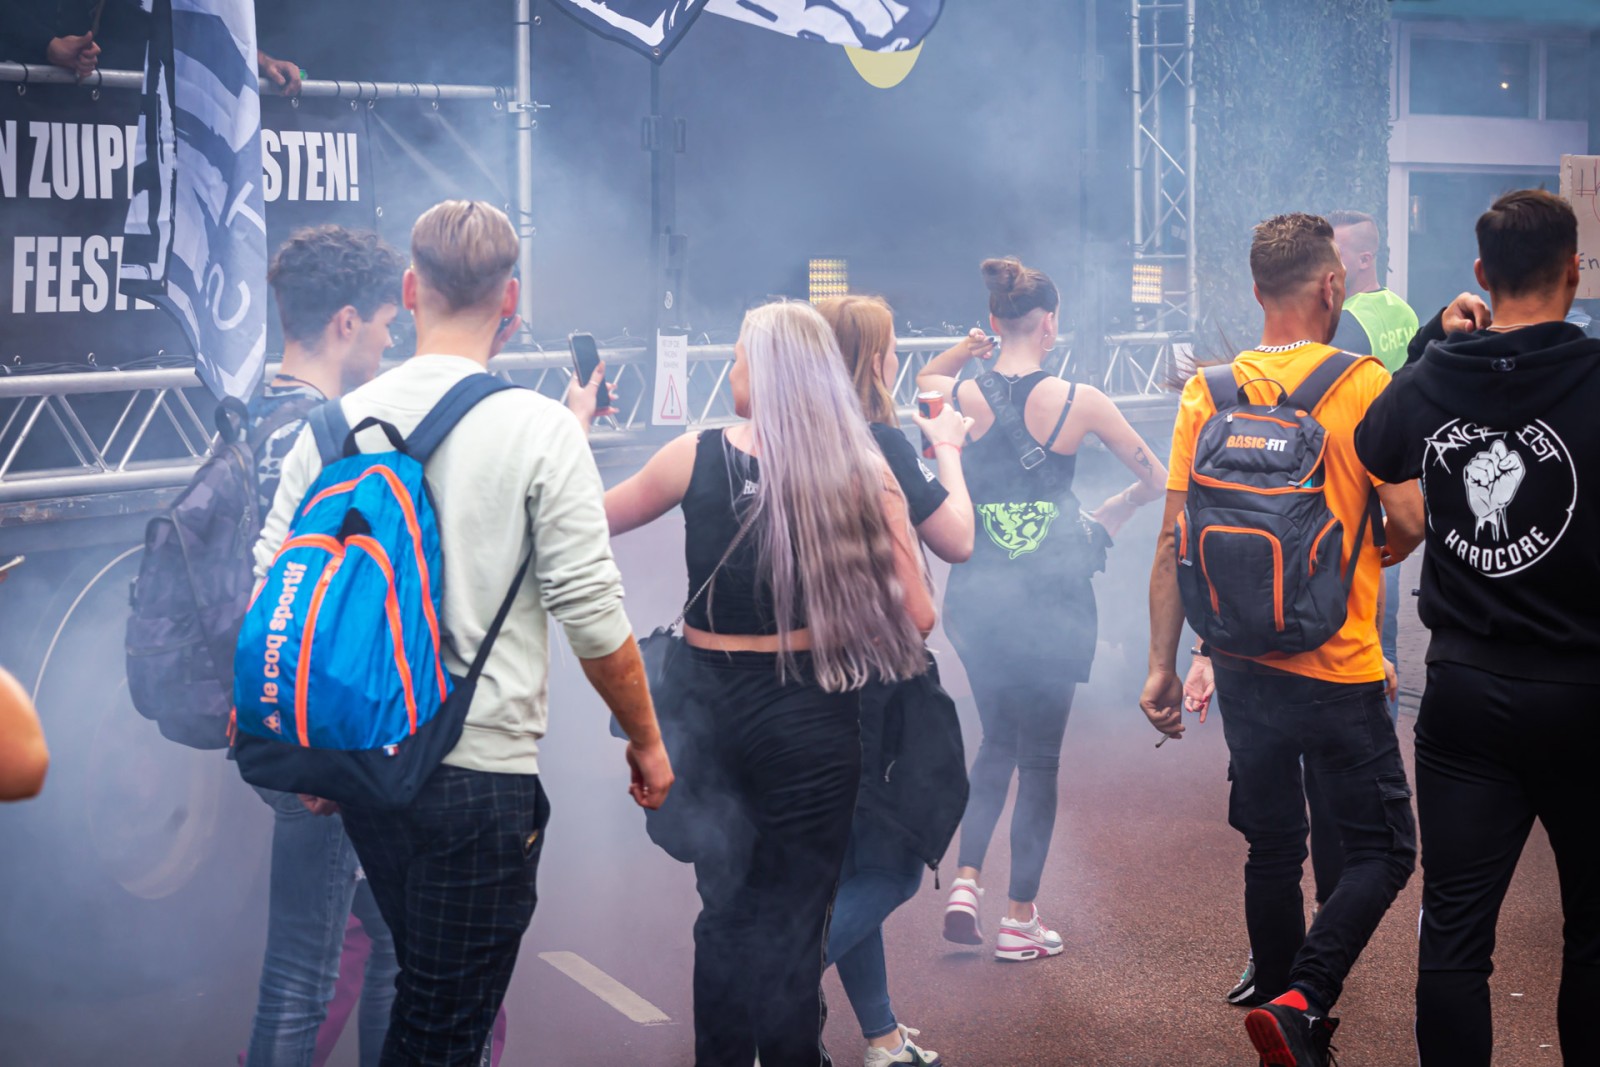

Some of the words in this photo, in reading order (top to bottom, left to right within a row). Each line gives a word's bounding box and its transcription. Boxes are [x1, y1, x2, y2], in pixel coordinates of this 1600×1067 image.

[1226, 434, 1288, 452] BASIC-FIT
[1444, 526, 1550, 571] HARDCORE
[270, 562, 307, 631] sportif
[264, 635, 287, 678] coq
[261, 683, 278, 703] le
